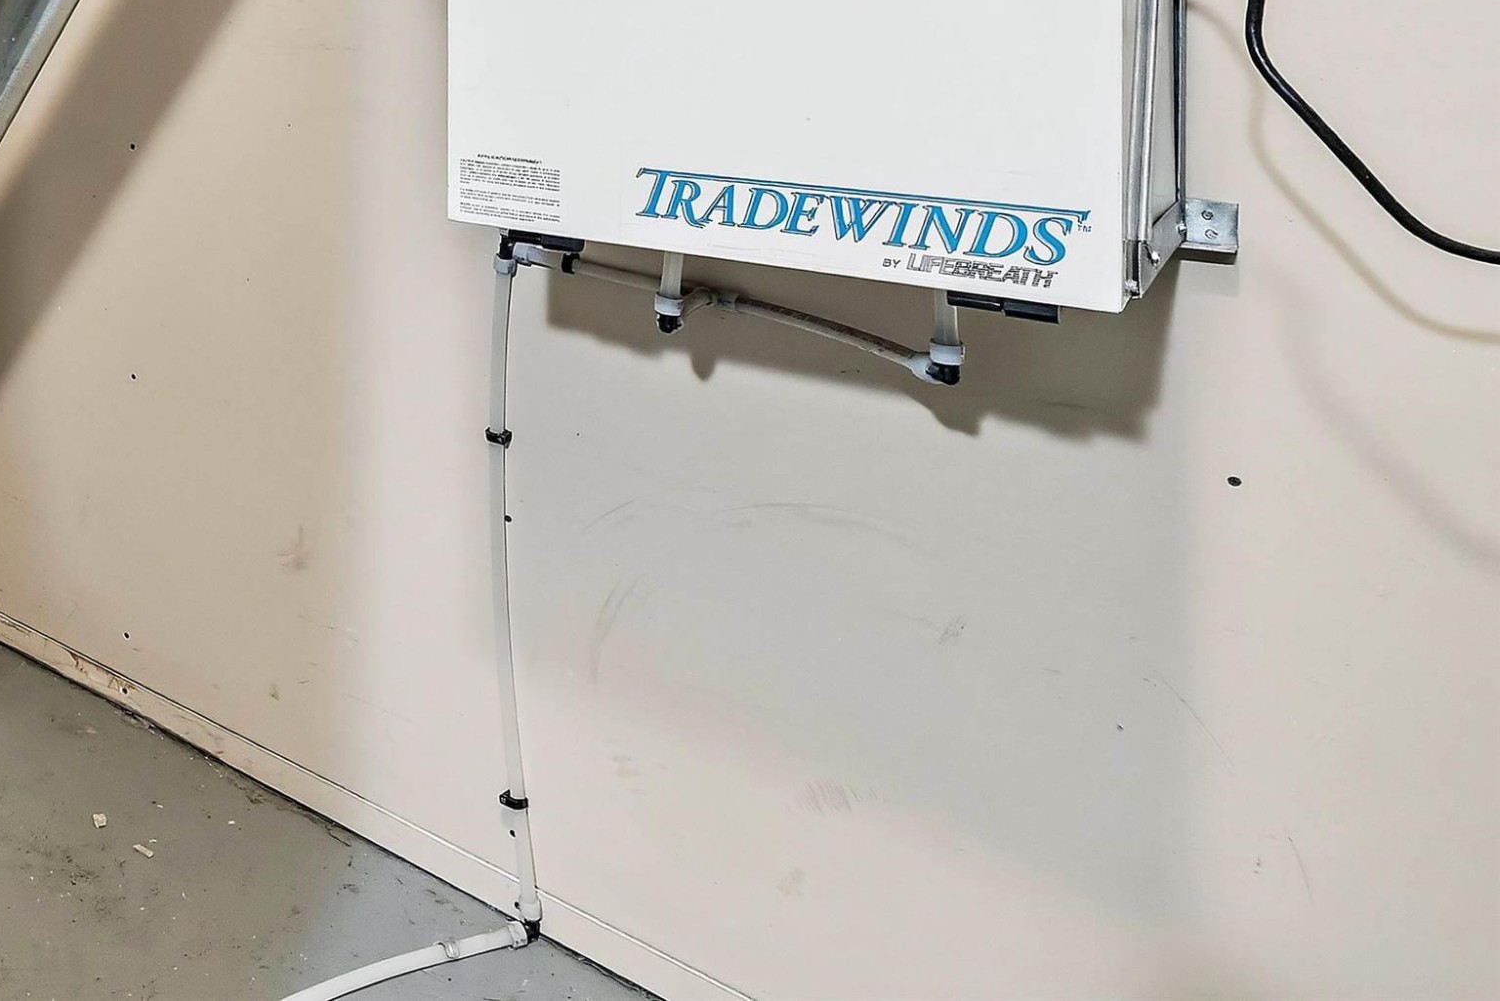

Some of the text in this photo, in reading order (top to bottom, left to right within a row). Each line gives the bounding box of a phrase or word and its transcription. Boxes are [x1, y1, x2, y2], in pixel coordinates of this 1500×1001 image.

[636, 167, 1091, 266] TRADEWINDS
[883, 252, 1058, 289] BY LIFEBREATH
